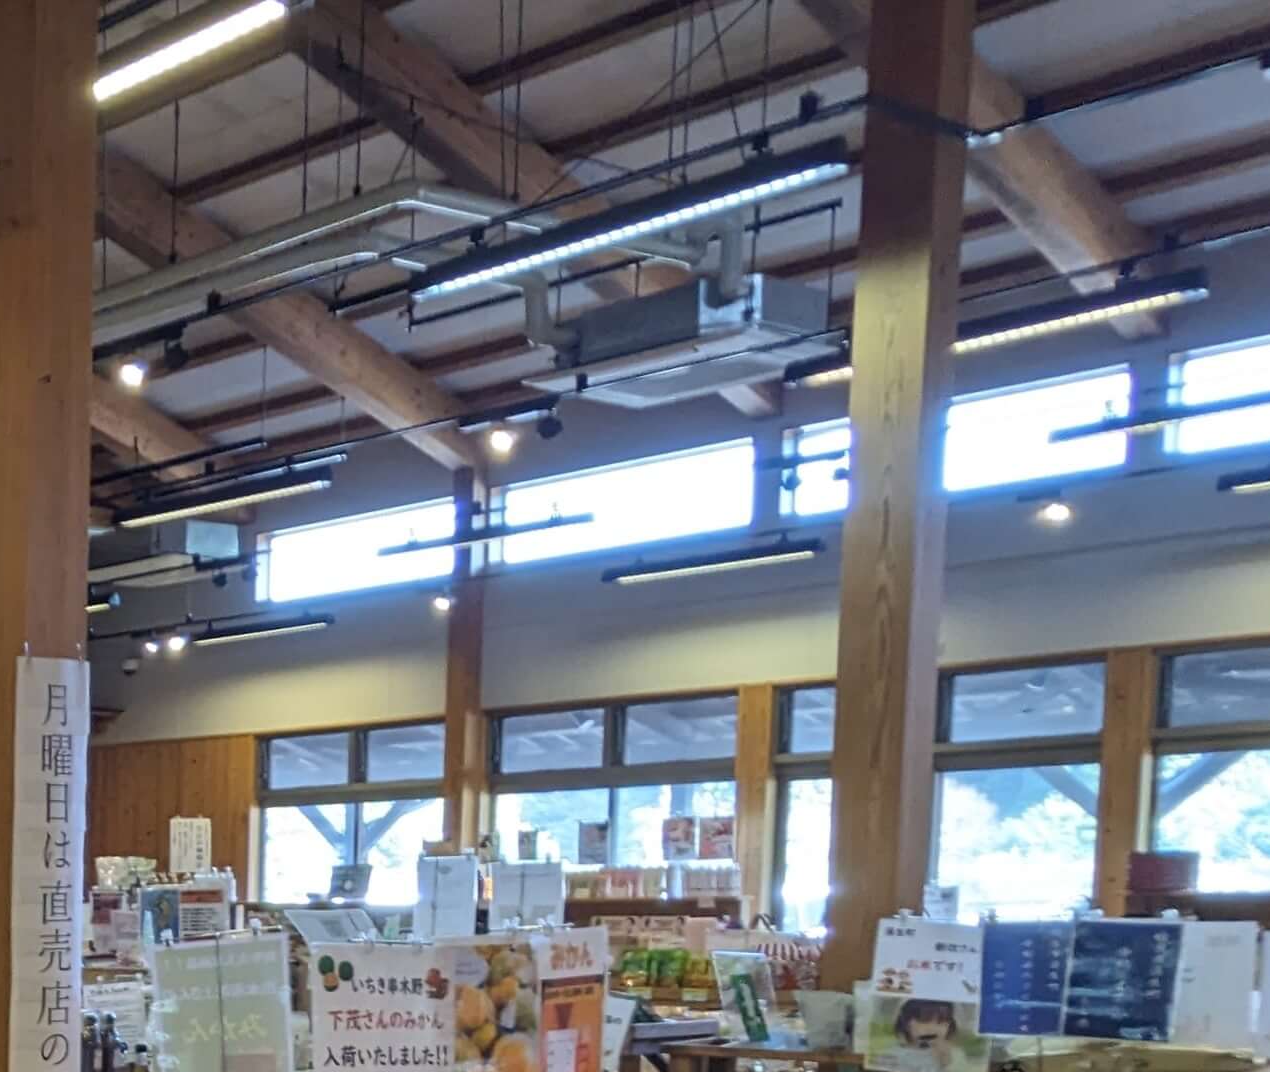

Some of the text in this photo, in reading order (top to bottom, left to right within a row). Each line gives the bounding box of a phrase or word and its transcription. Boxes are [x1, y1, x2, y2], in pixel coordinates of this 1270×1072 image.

[549, 942, 593, 971] みかん
[350, 975, 424, 997] いちき串木野
[327, 1008, 445, 1034] 下茂さんのみかん
[322, 1045, 449, 1069] 入荷いたしました!!
